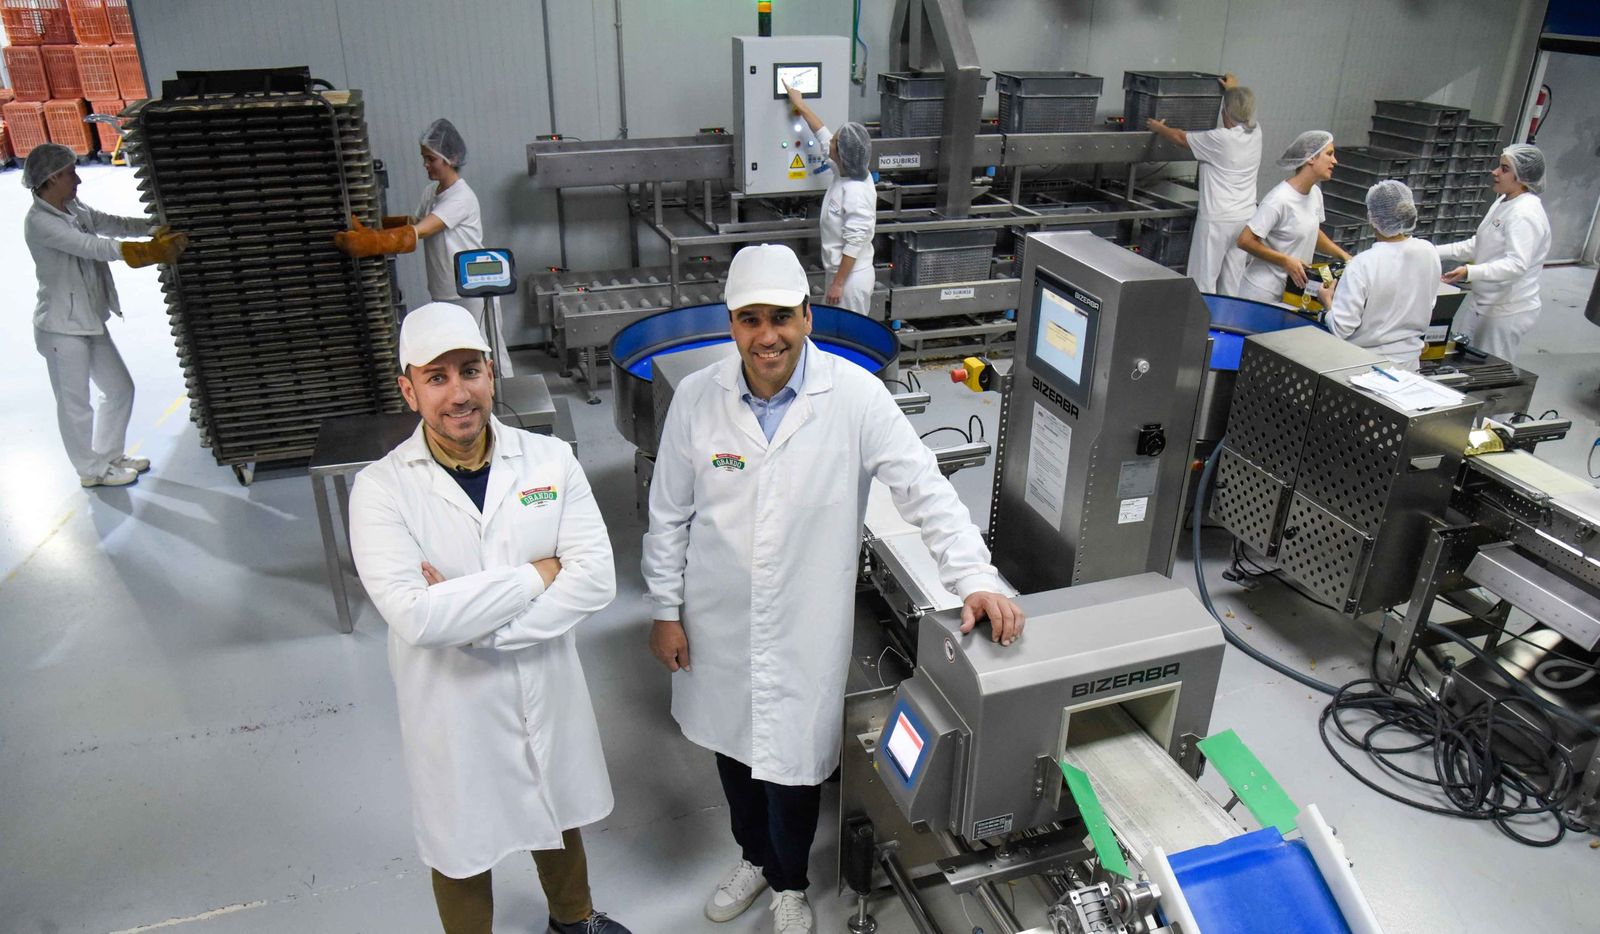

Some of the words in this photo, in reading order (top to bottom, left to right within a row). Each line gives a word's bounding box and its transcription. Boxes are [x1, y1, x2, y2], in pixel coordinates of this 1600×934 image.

[1075, 291, 1100, 311] BIZERBA
[1032, 376, 1079, 420] BIZERBA
[1071, 662, 1180, 698] BIZERBA
